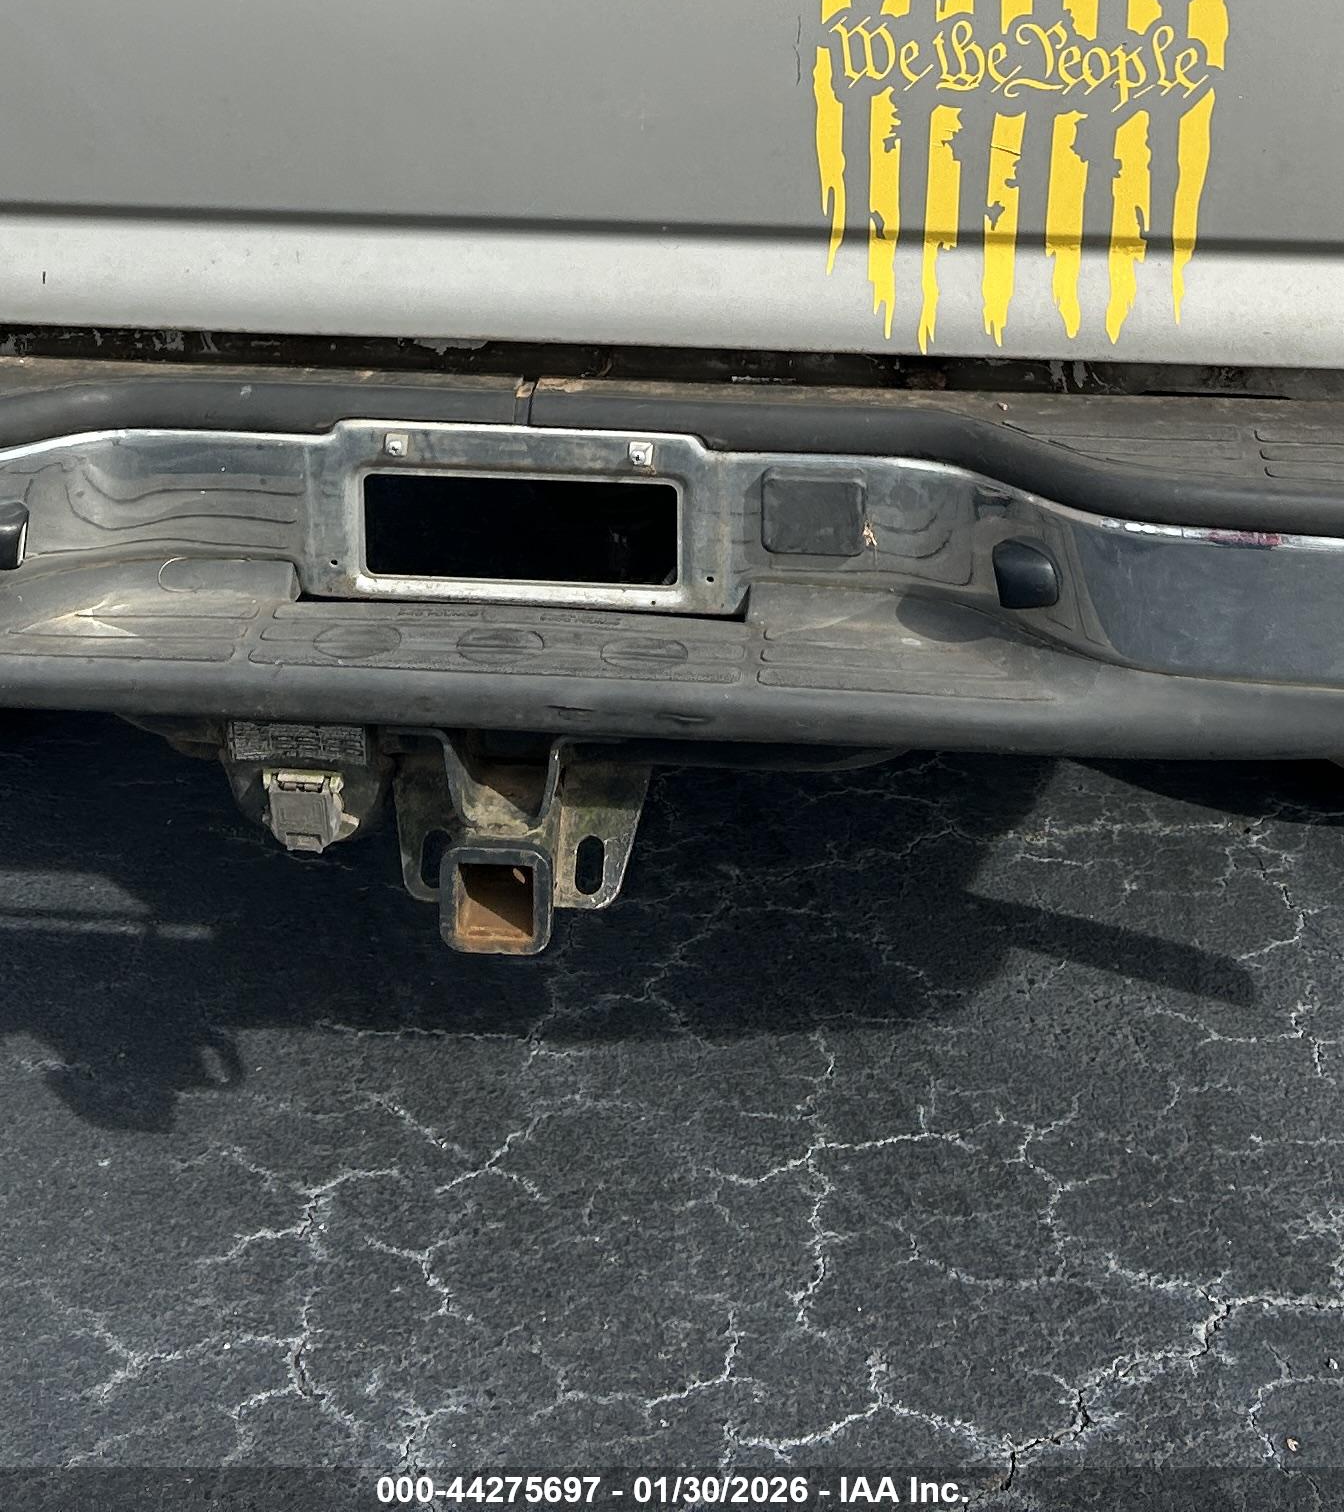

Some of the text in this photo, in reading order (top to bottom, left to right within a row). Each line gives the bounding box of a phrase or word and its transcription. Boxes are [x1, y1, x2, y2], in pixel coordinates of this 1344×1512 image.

[829, 16, 1209, 113] We the People
